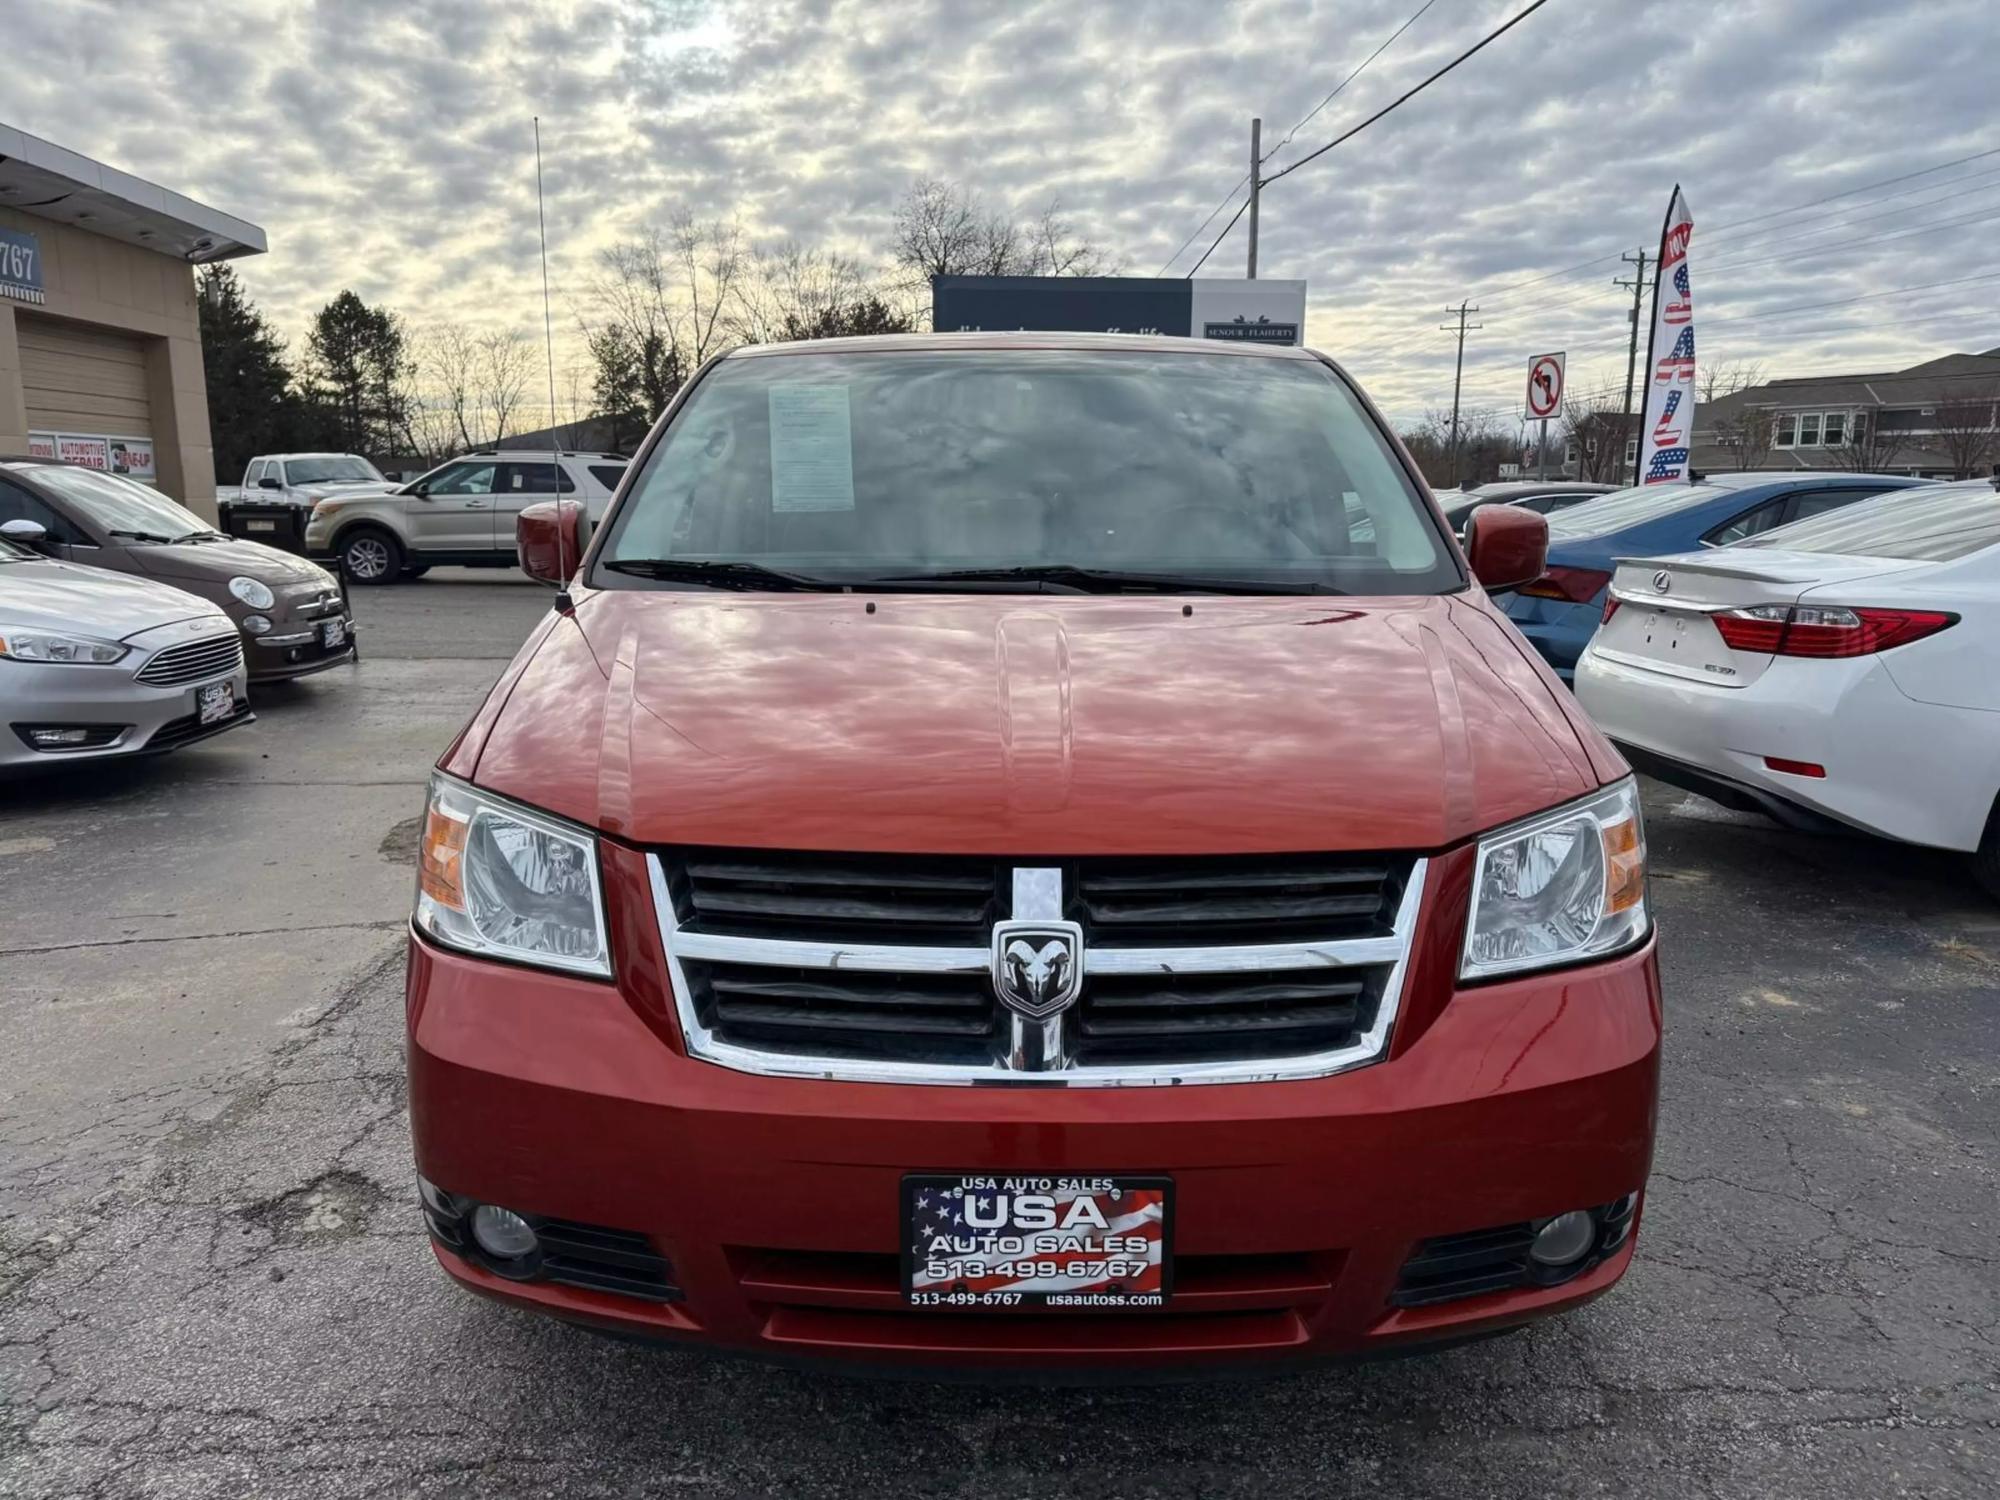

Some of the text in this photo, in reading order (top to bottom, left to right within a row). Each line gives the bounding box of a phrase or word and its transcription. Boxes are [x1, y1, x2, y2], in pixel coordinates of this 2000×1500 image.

[0, 241, 33, 281] 767
[61, 442, 105, 456] AUTOMOTIVE
[64, 456, 104, 469] REPAIR
[961, 1177, 1113, 1192] USA AUTO SALES
[964, 1194, 1110, 1230] USA
[927, 1236, 1149, 1254] AUTO SALES
[927, 1260, 1150, 1279] 513-499-6767
[911, 1292, 1163, 1306] 513-499-6767 usaautoss.com
